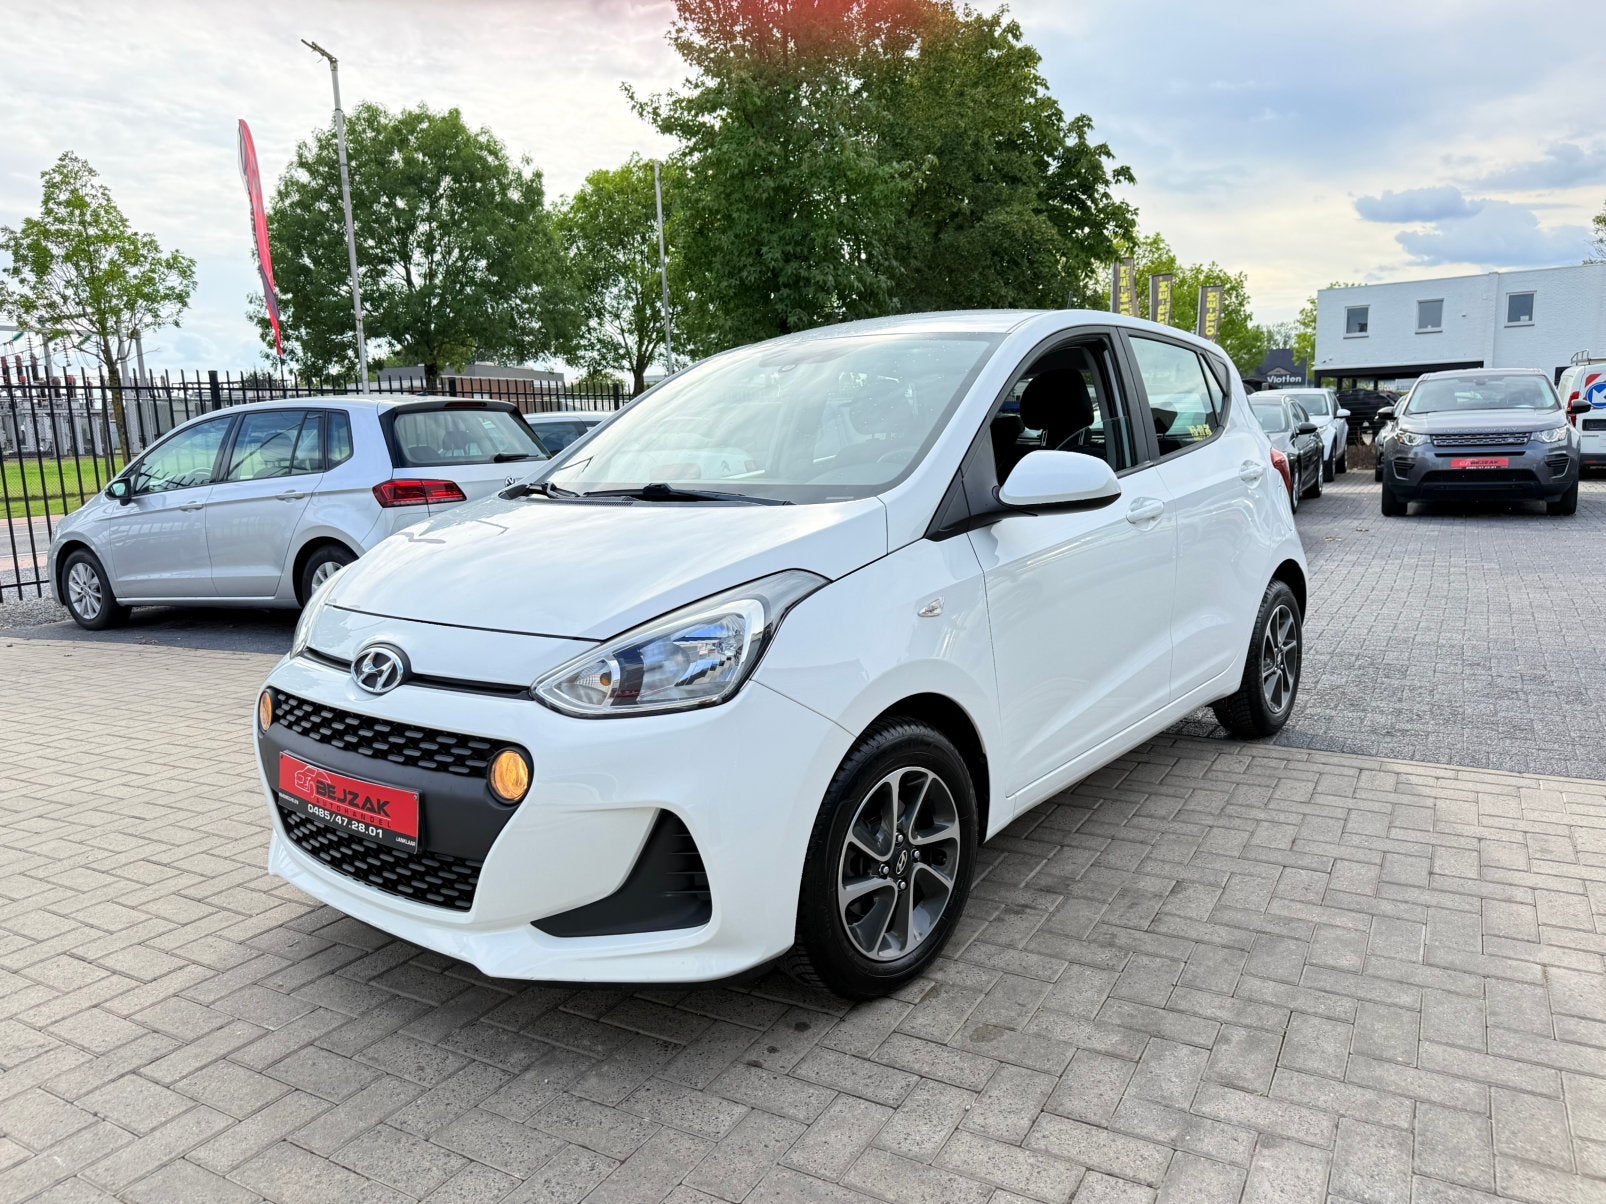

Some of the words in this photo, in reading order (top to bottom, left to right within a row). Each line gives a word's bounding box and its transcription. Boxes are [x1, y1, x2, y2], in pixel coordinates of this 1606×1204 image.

[1205, 292, 1218, 336] OTR-EM
[316, 778, 391, 818] BEJZAK
[316, 797, 392, 829] AUTOHANDEL
[307, 803, 383, 839] 0485/47.28.01
